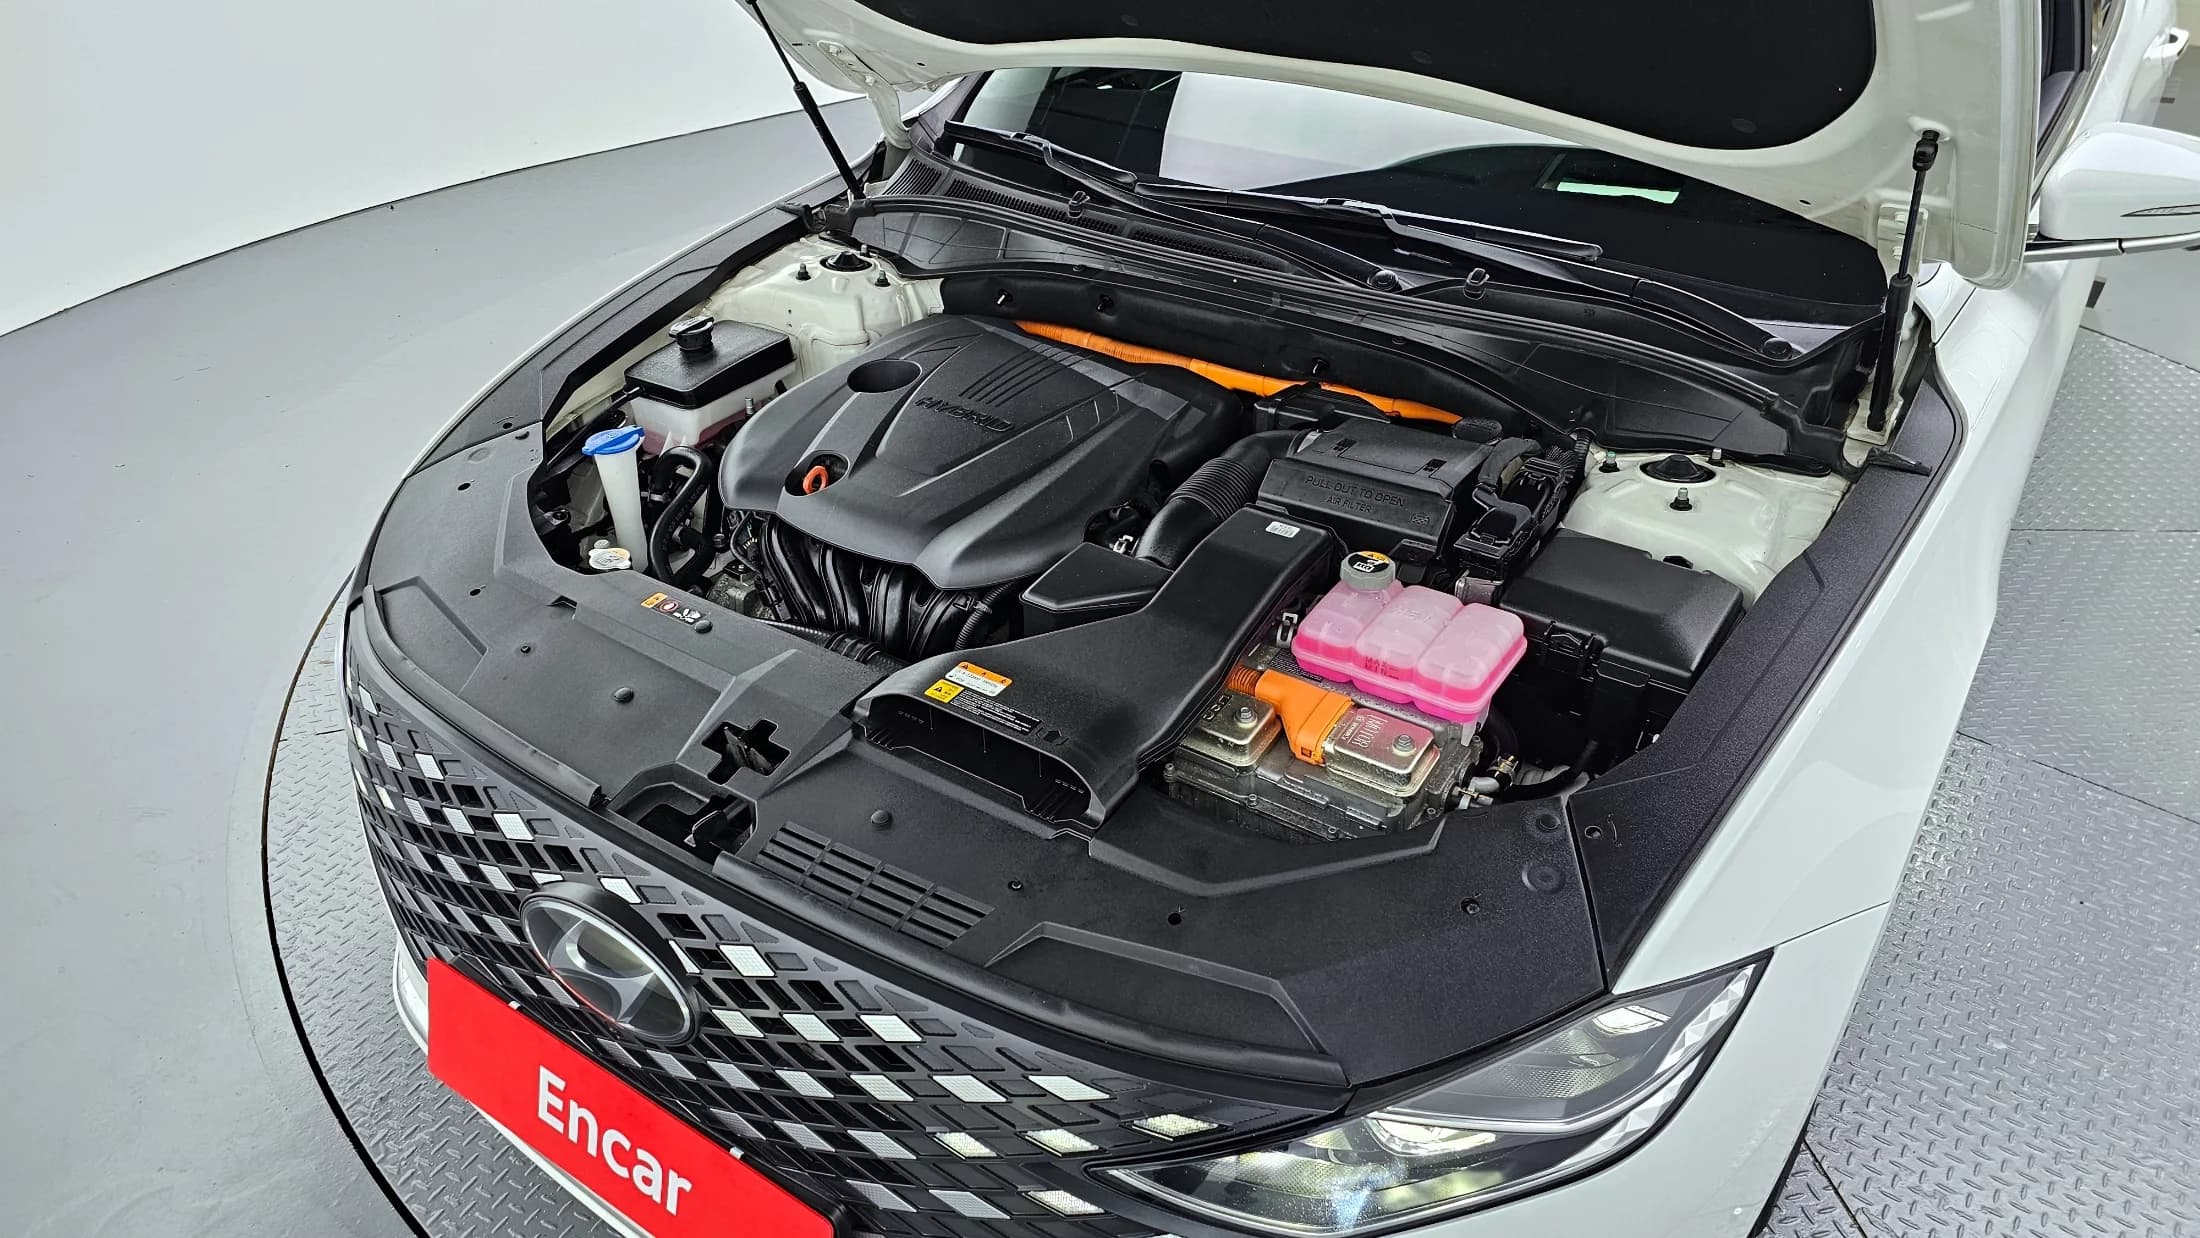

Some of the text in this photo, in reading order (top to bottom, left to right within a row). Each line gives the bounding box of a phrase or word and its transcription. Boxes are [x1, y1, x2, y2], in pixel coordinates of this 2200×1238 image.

[1305, 475, 1405, 507] PULL OUT TO OPEN
[1326, 495, 1372, 513] AIR FILTER
[538, 1065, 693, 1216] Encar
